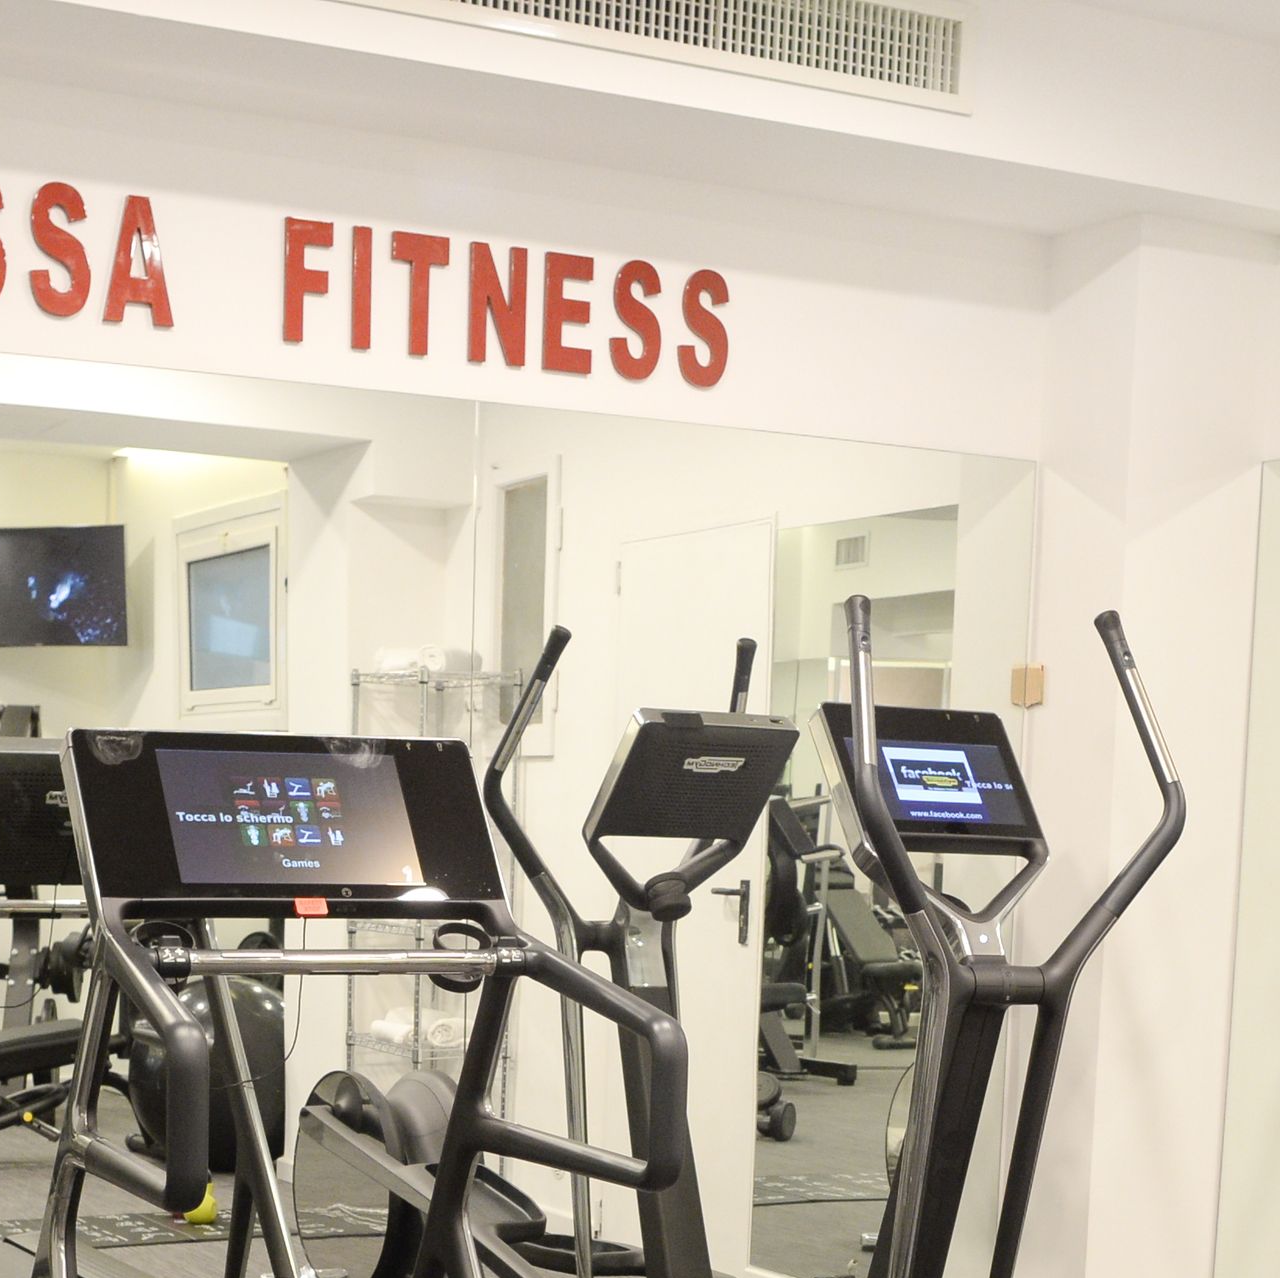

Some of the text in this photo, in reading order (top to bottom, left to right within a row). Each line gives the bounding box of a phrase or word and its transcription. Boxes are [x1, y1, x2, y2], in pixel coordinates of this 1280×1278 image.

[282, 215, 730, 390] FITNESS
[964, 780, 992, 789] Tcca
[175, 811, 294, 824] Tocca lo schermo
[910, 810, 983, 820] www.facebook.com
[282, 858, 320, 868] Games
